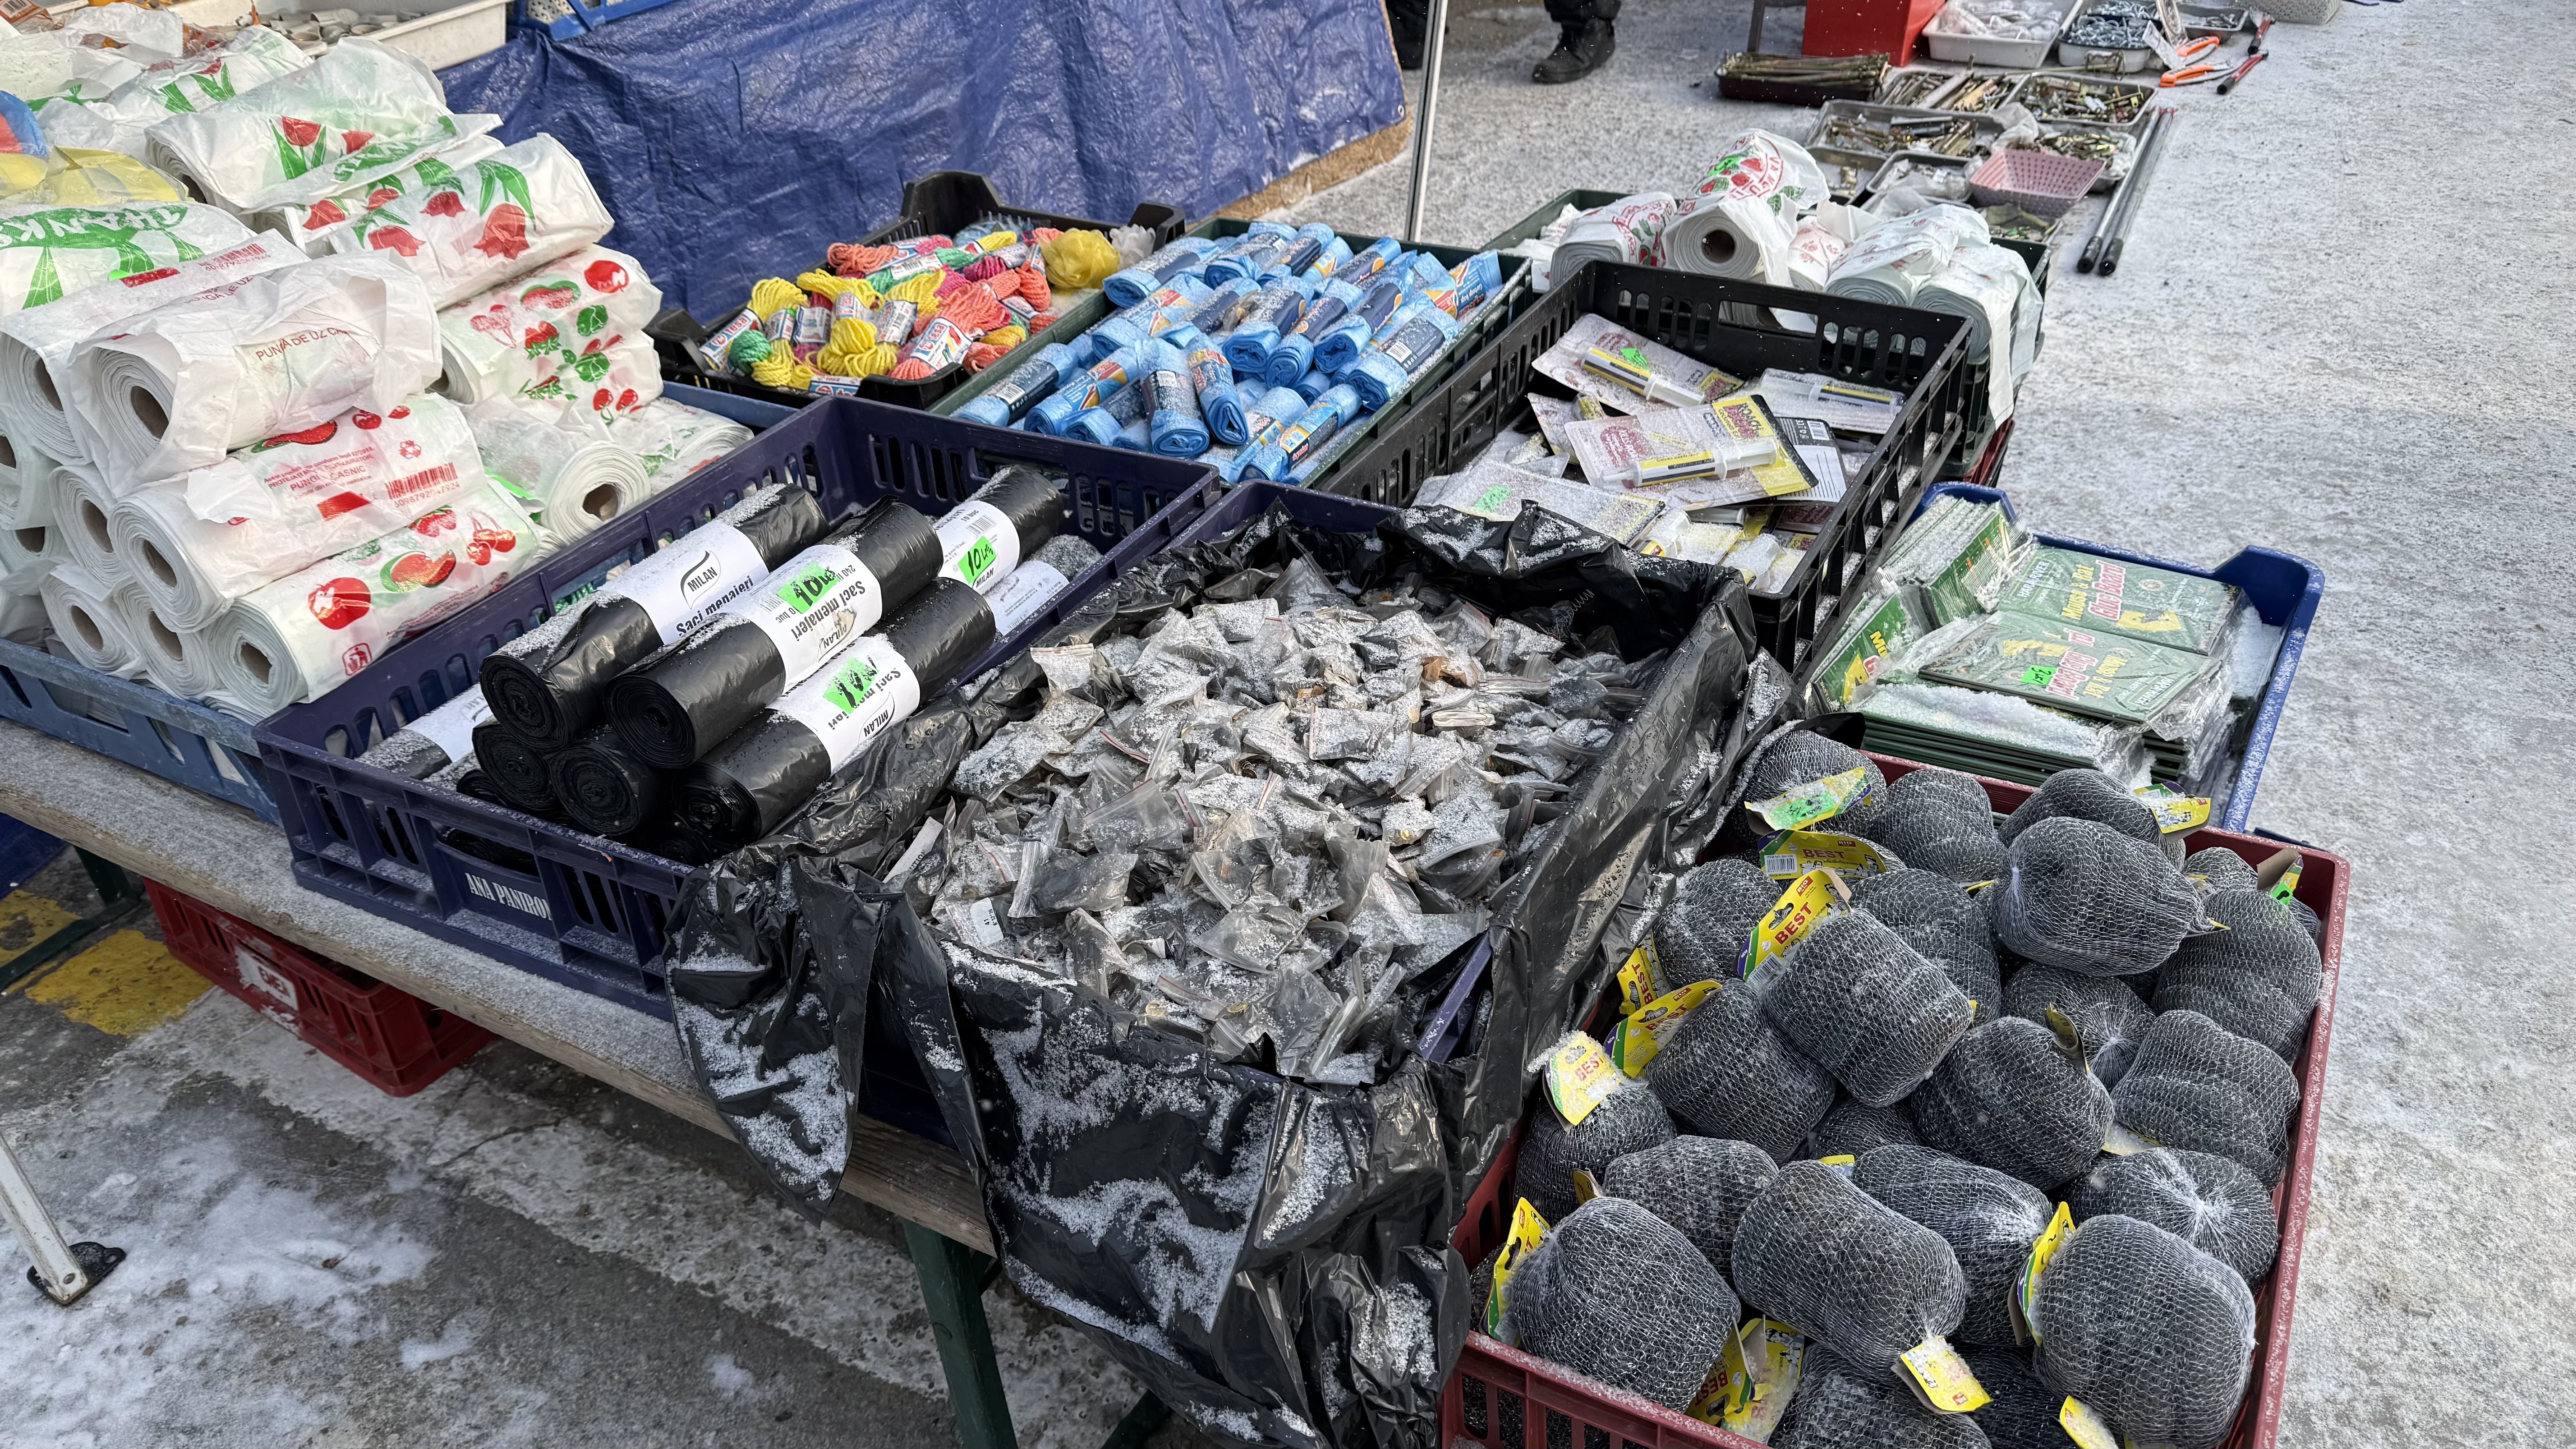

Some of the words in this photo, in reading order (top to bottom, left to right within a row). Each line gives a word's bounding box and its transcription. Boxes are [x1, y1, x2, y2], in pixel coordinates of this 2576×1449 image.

[291, 334, 310, 346] DE
[290, 474, 321, 491] PUNGI
[967, 548, 981, 577] 10
[2070, 563, 2094, 582] Rat
[687, 566, 718, 593] MILAN
[976, 567, 994, 588] MILAN
[2061, 589, 2088, 621] Mouse
[864, 709, 889, 737] MILAN
[1802, 848, 1845, 860] BEST
[464, 872, 496, 902] ANA
[1774, 902, 1813, 946] BEST
[1633, 962, 1654, 1005] BEST
[1692, 1367, 1729, 1407] BEST
